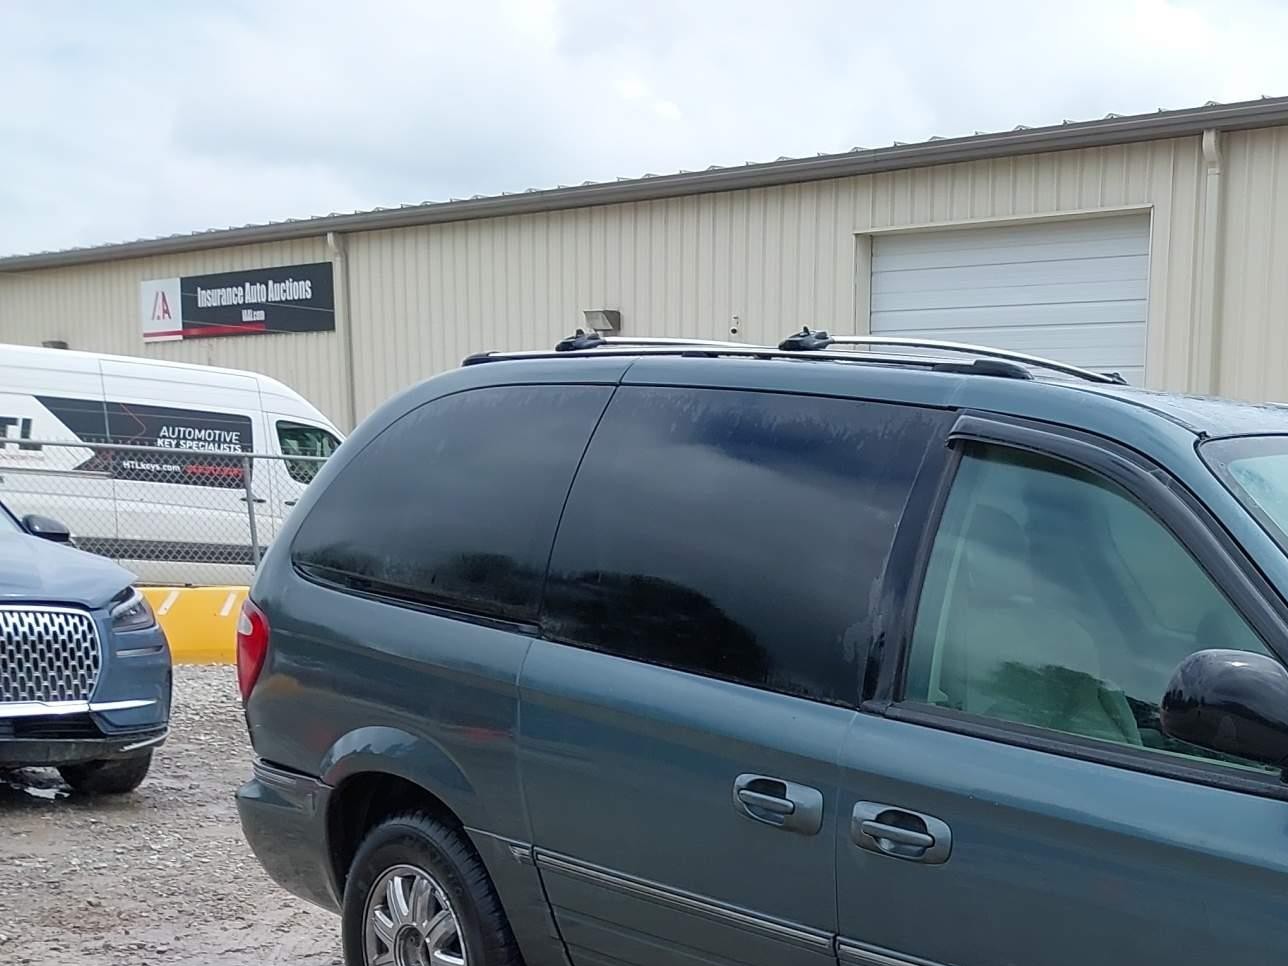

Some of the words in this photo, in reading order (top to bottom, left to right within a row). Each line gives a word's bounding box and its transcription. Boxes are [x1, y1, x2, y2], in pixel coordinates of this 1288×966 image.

[197, 286, 244, 308] Insurance
[244, 282, 267, 304] Auto
[268, 278, 312, 303] Auctions
[159, 426, 241, 444] AUTOMOTIVE
[157, 438, 178, 449] KEY
[179, 440, 242, 453] SPECIALISTS
